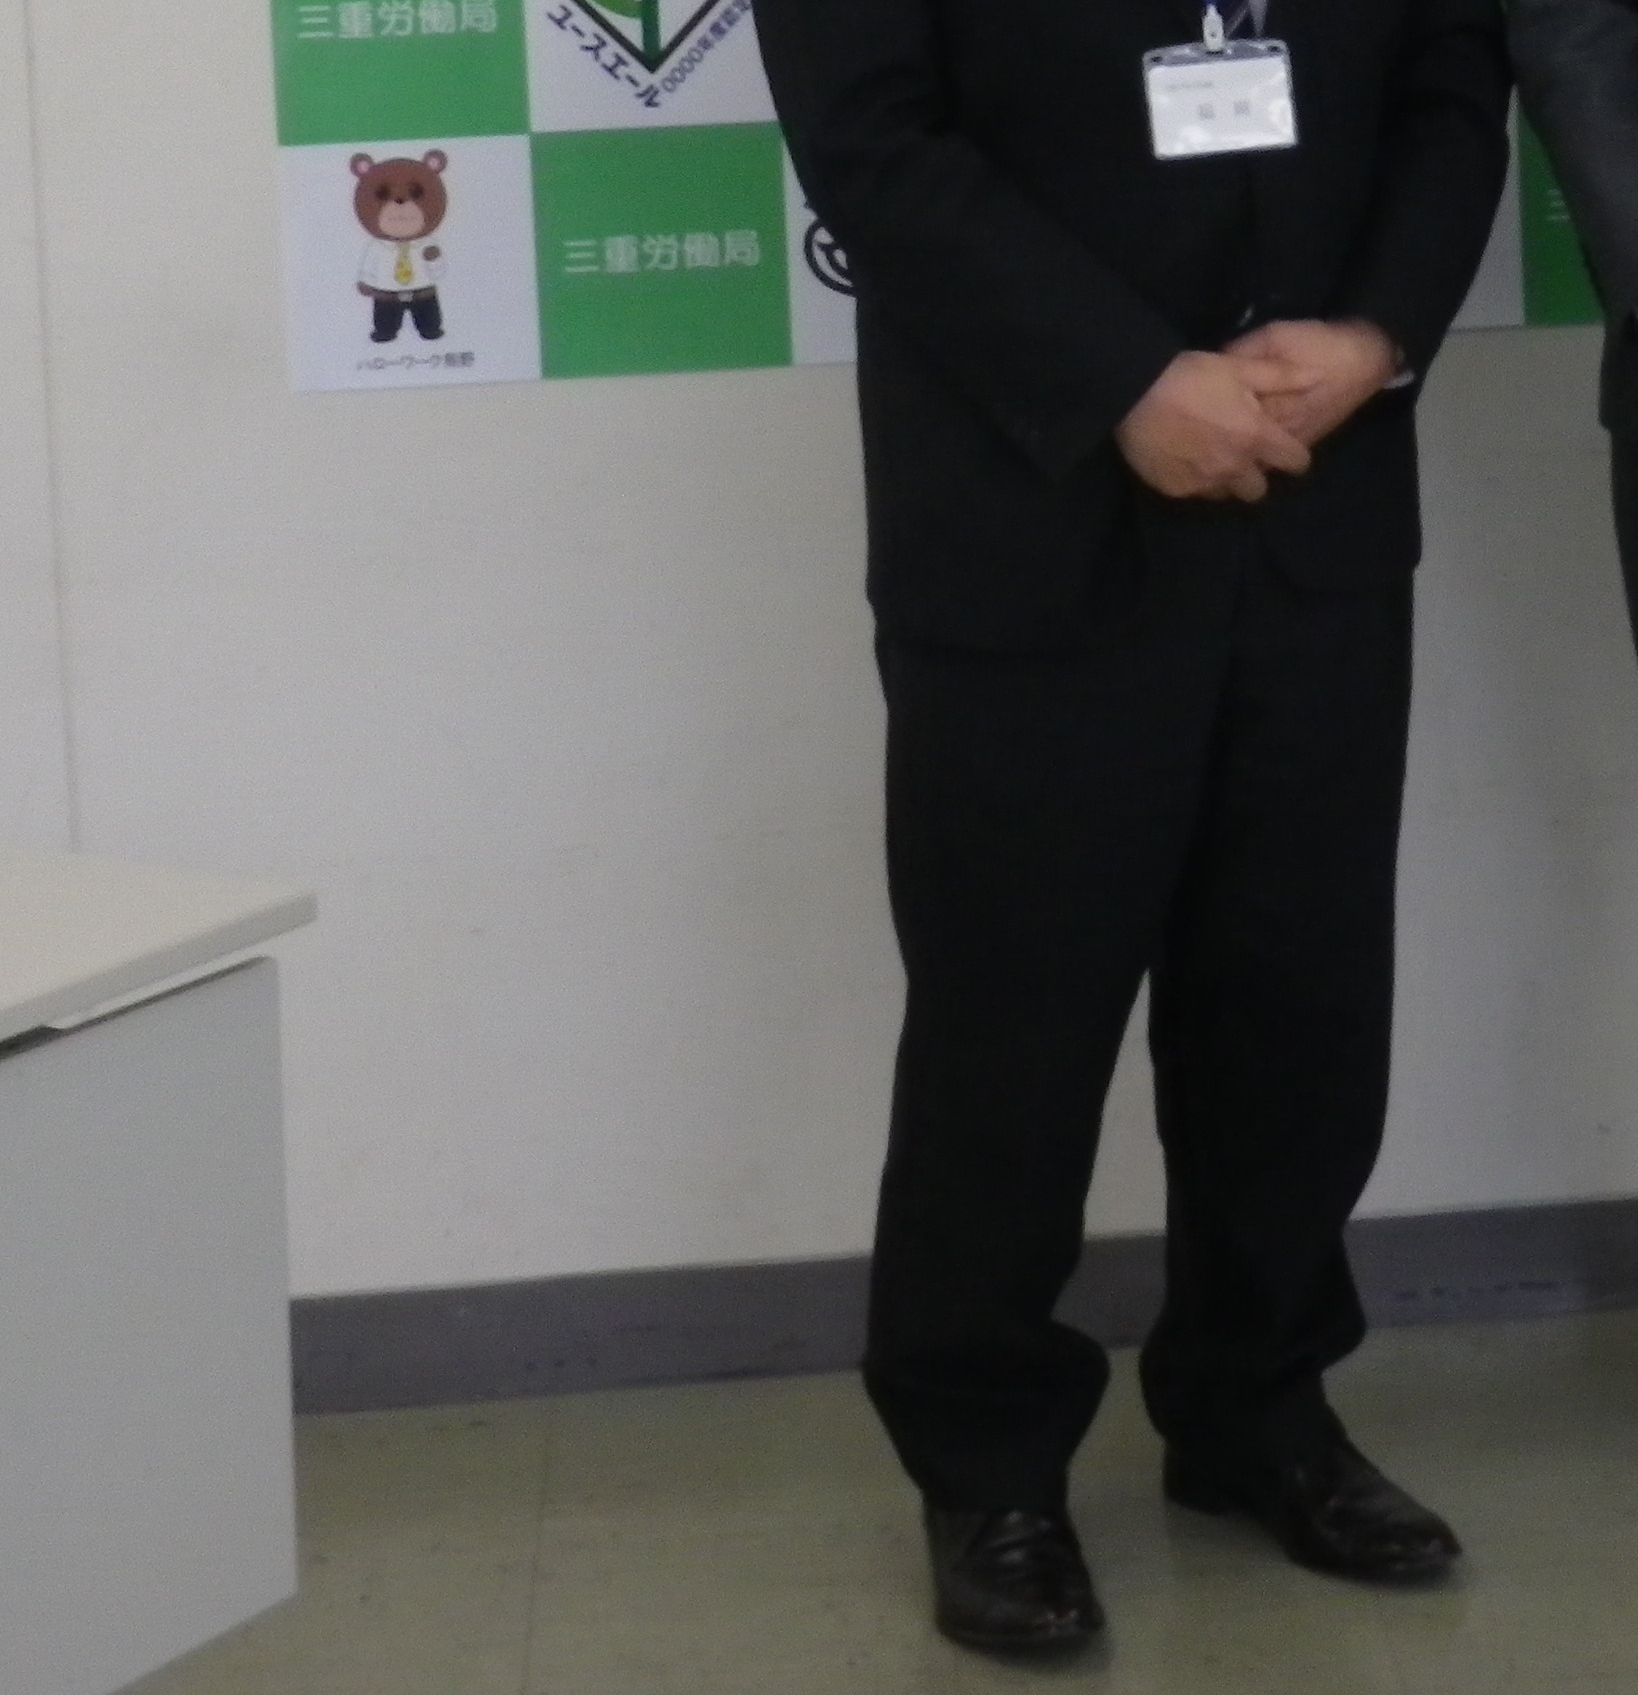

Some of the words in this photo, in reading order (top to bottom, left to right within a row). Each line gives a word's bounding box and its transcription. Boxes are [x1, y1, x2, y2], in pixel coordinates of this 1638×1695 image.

[547, 5, 660, 108] ユースエール
[564, 230, 760, 274] 三重労働局
